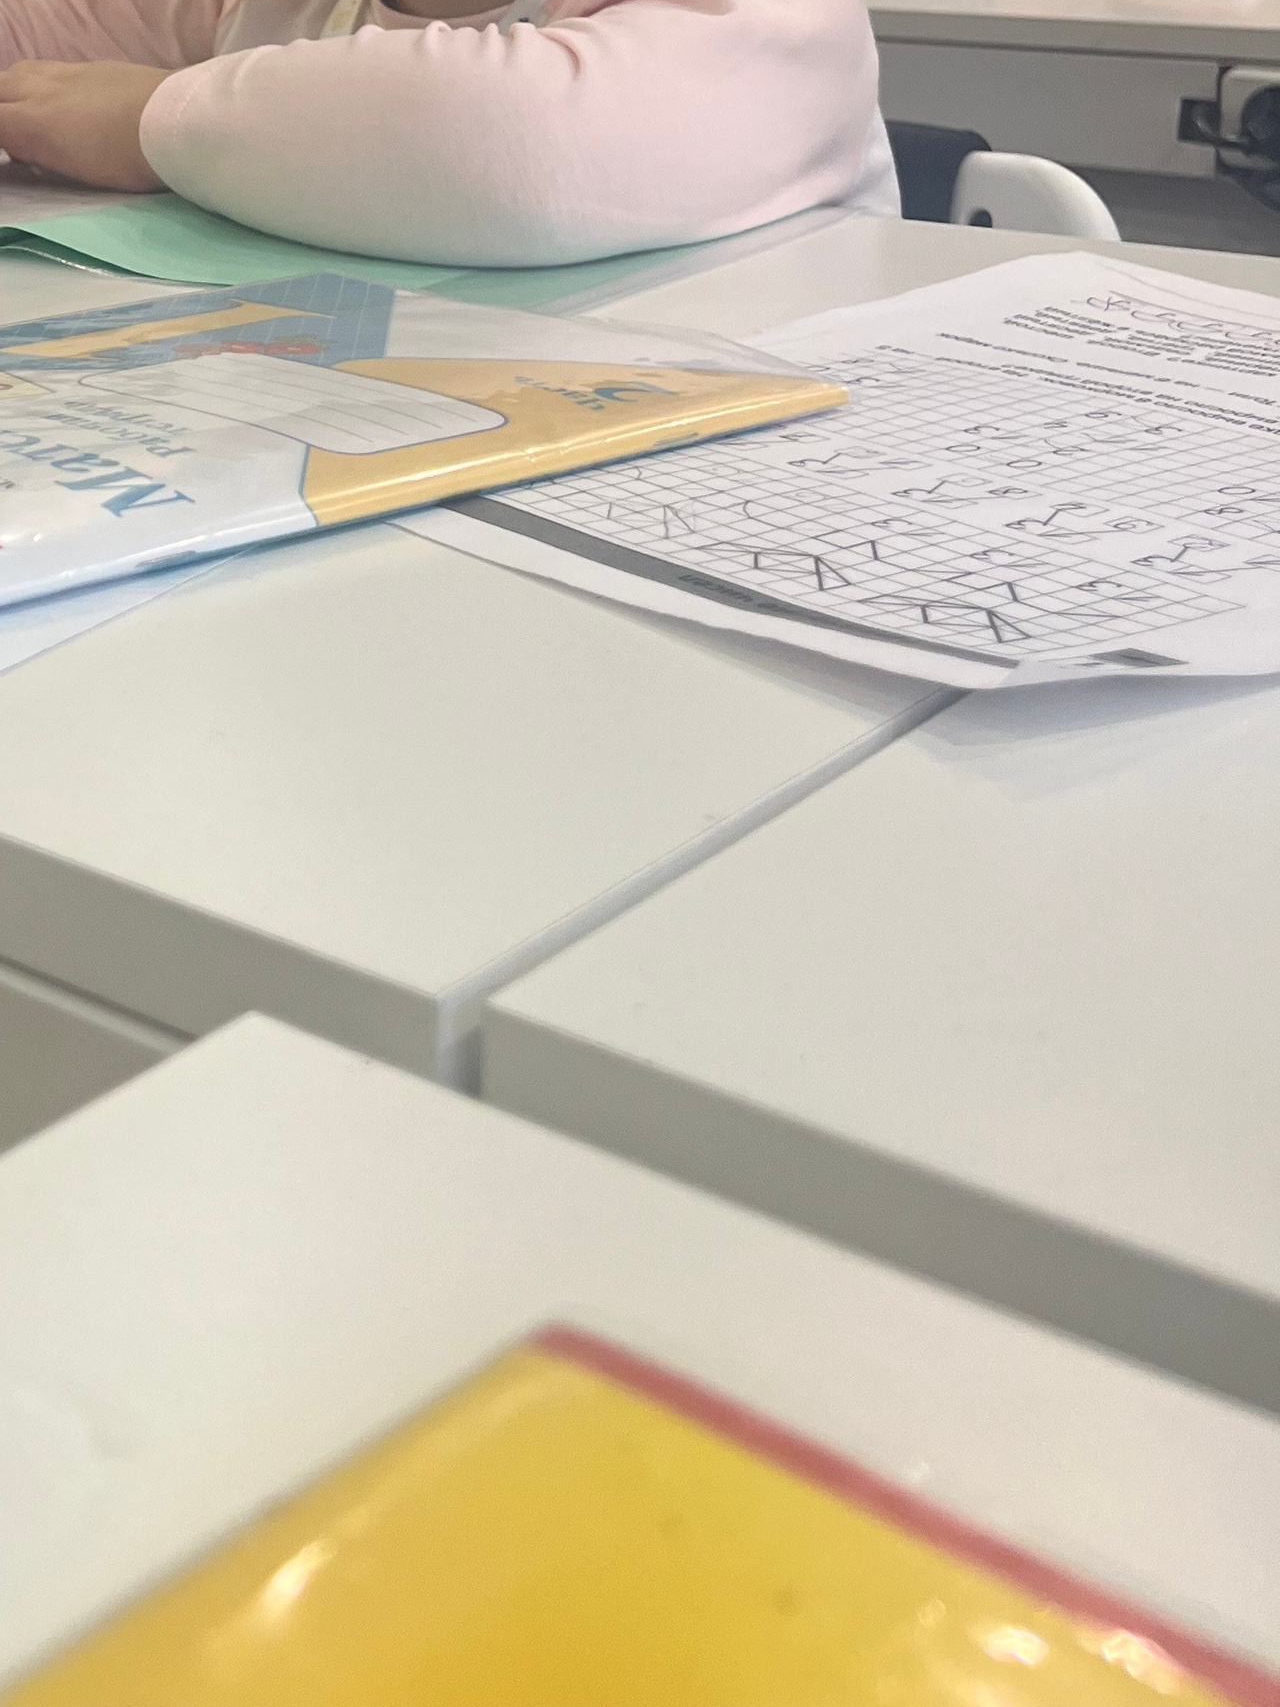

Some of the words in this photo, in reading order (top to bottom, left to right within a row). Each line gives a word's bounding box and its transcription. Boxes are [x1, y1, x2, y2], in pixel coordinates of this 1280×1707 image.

[1153, 401, 1253, 426] выросло
[1183, 400, 1280, 425] выросло
[41, 413, 197, 457] Рабочая
